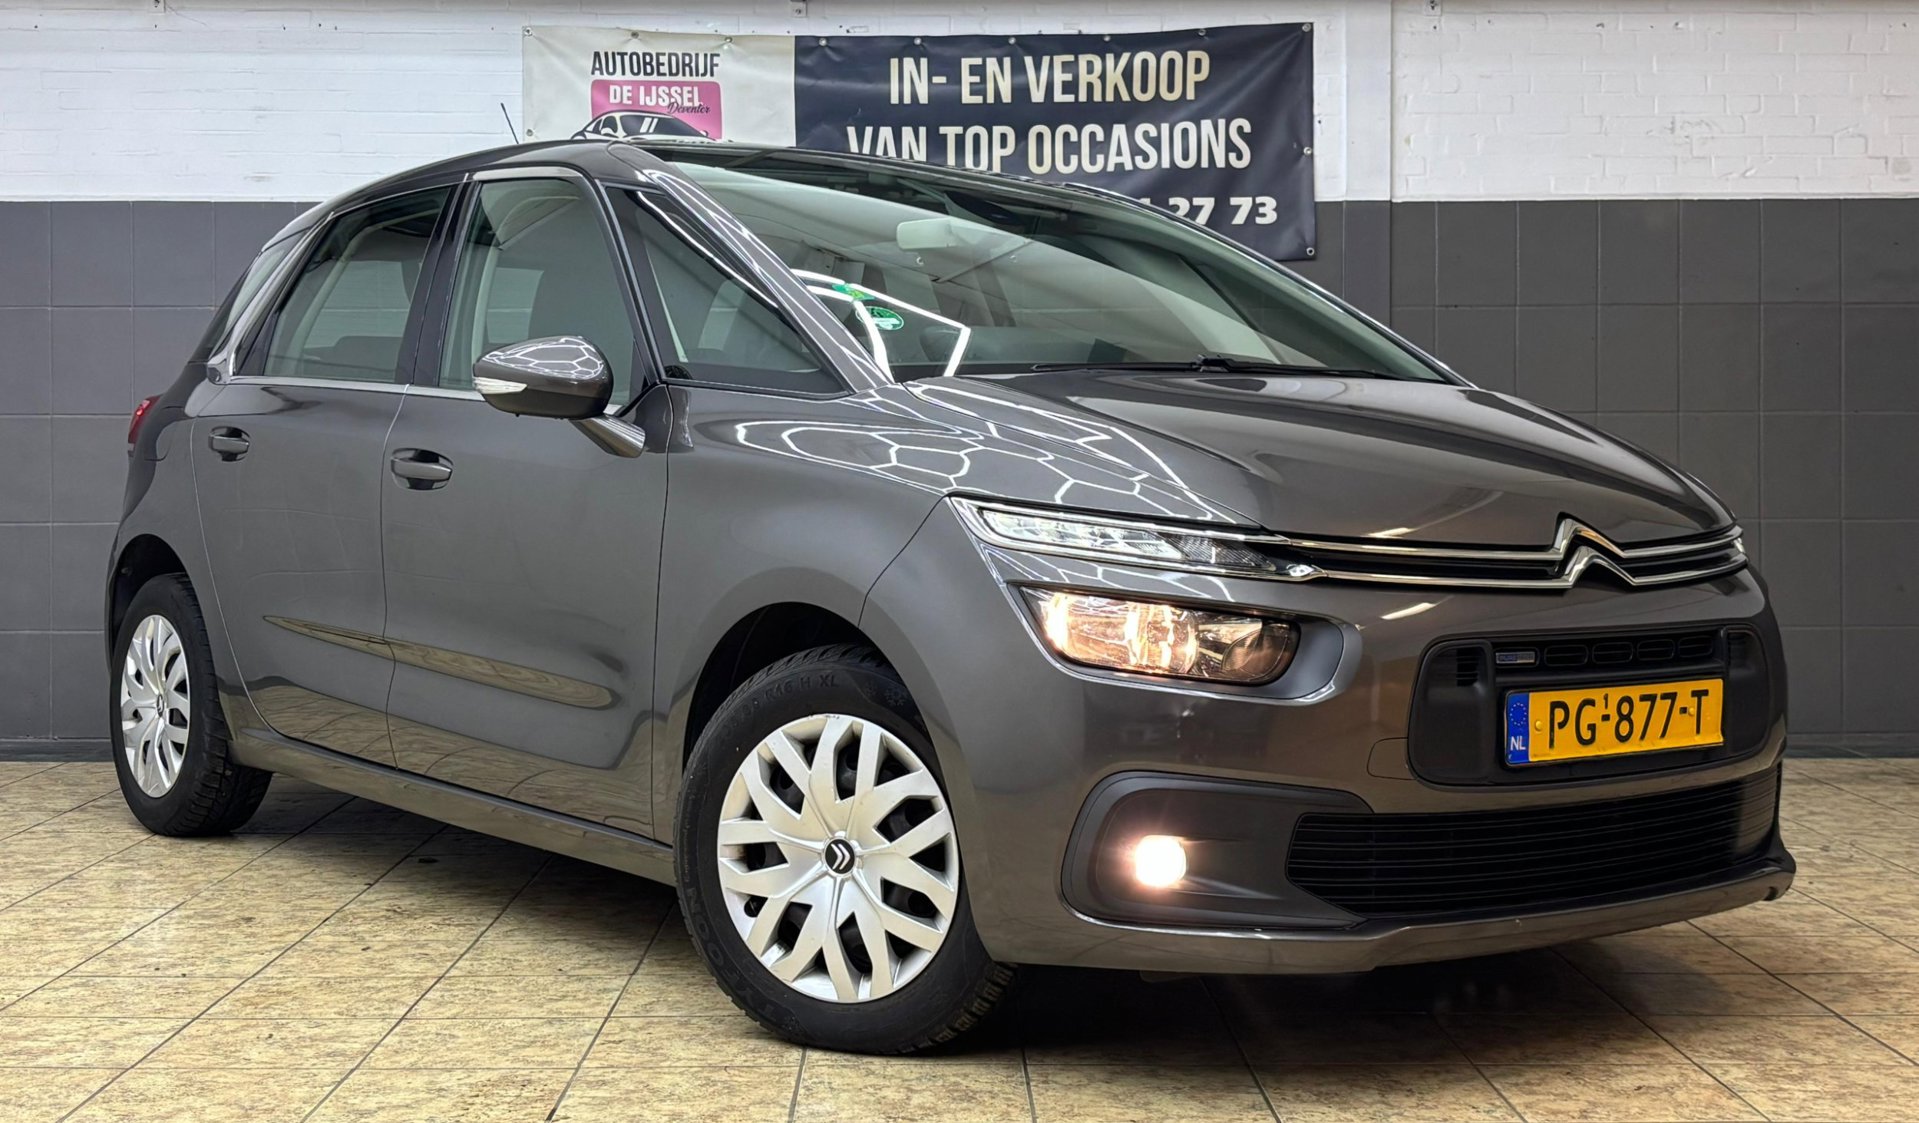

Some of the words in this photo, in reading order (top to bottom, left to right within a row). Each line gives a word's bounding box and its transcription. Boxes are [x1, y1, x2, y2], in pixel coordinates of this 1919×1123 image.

[591, 51, 720, 77] AUTOBEDRIJF
[890, 57, 947, 104] IN-
[961, 57, 1011, 104] EN
[1024, 50, 1210, 103] VERKOOP
[609, 85, 632, 104] DE
[639, 85, 703, 106] IJSSEL
[667, 102, 710, 114] Deventer
[846, 126, 927, 162] VAN
[939, 124, 1016, 173] TOP
[1028, 118, 1252, 174] OCCASIONS
[1229, 196, 1277, 224] 73
[819, 673, 840, 689] XL
[1548, 689, 1710, 750] PG-877-T
[1510, 736, 1526, 750] NL
